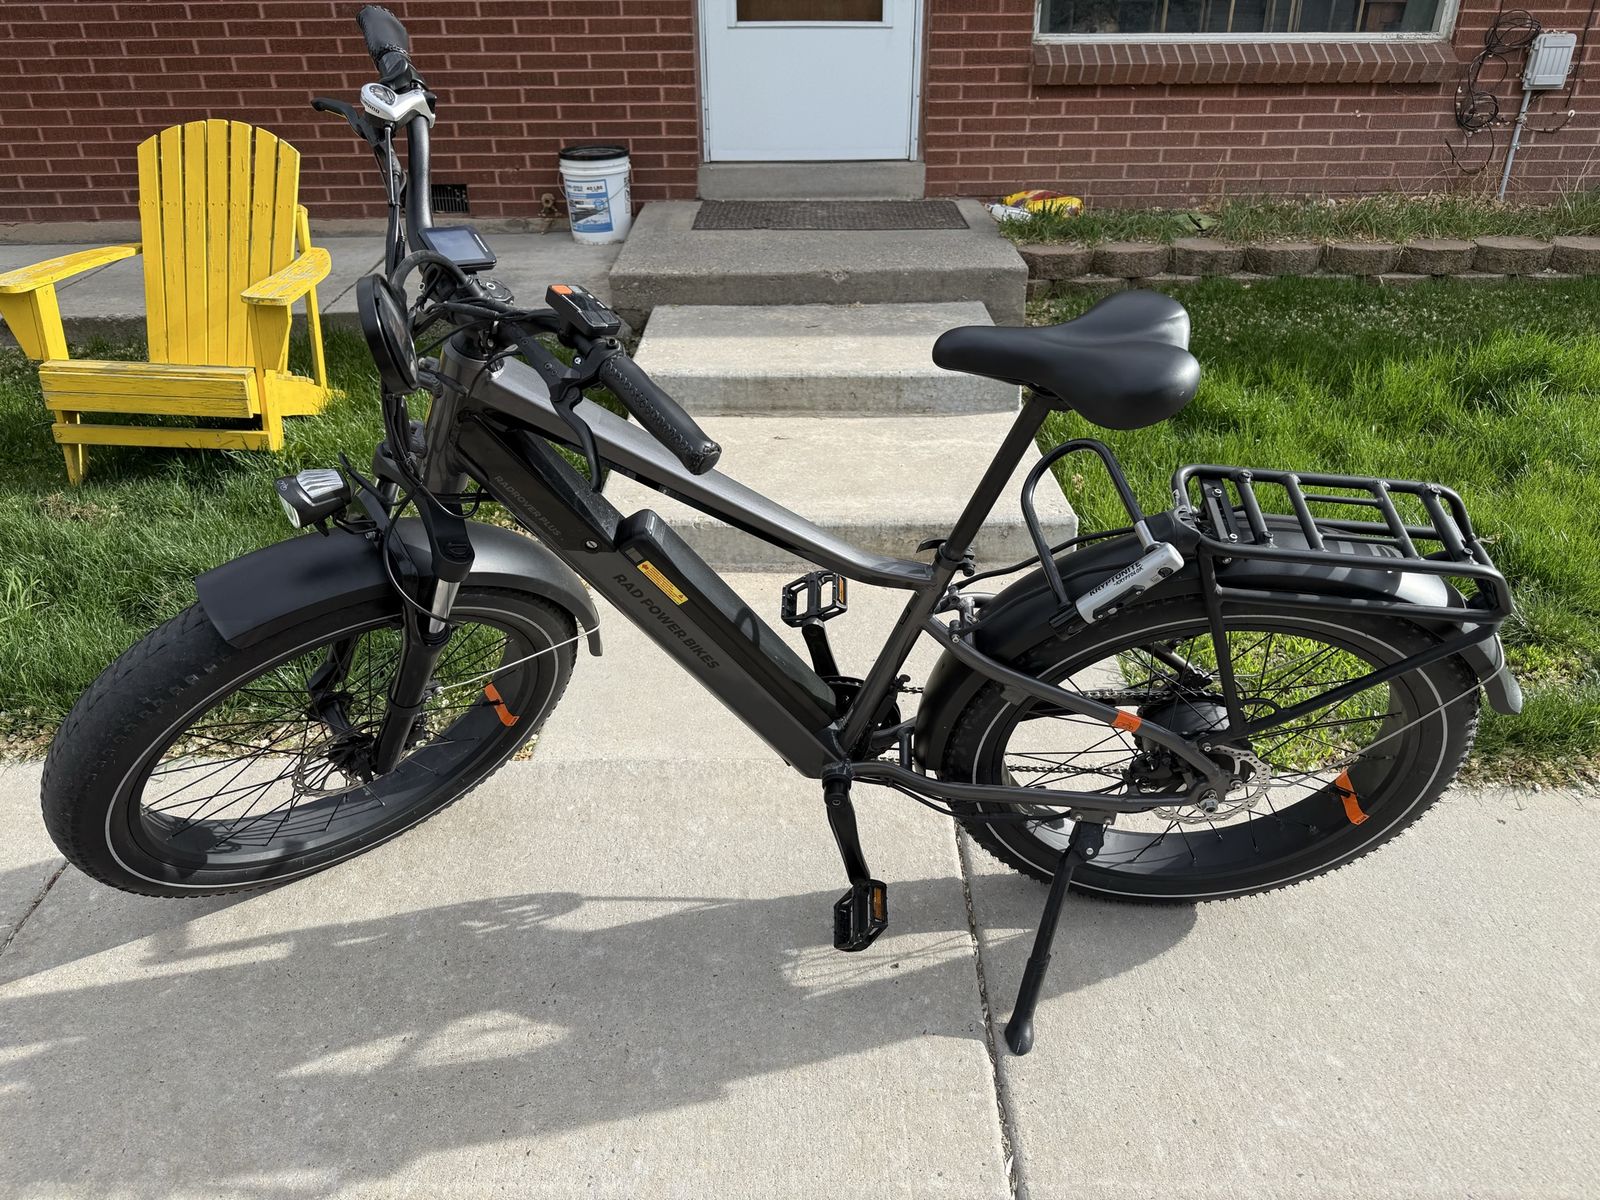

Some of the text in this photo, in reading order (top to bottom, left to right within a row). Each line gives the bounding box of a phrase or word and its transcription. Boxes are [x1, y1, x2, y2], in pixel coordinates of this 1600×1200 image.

[494, 475, 561, 537] RADROVER PLUS
[1089, 562, 1142, 596] KRYPTONITE
[613, 574, 644, 600] RAD
[641, 598, 687, 639] POWER
[681, 638, 721, 669] BIKES
